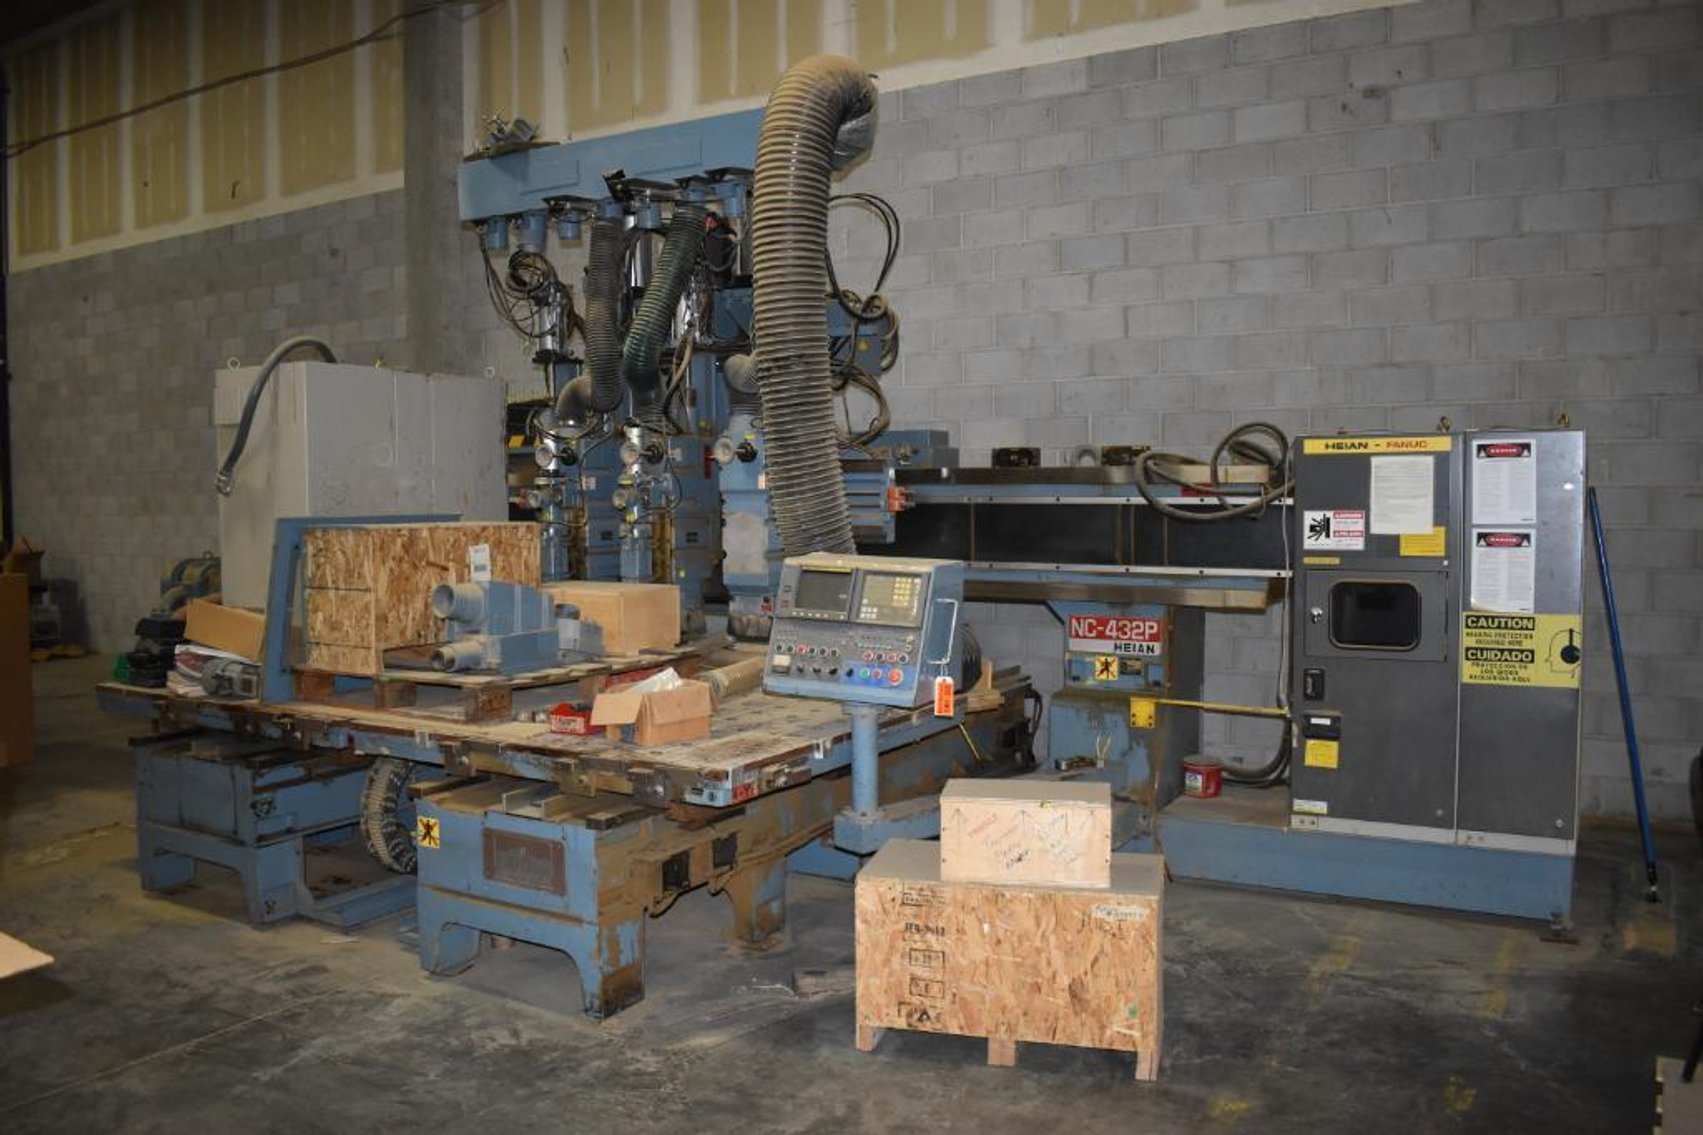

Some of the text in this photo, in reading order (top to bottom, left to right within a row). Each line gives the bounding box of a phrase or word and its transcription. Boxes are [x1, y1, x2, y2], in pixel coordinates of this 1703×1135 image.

[1325, 441, 1369, 451] HEIAN
[1386, 440, 1427, 449] FANUC
[1071, 618, 1158, 640] NC-432P
[1467, 616, 1533, 629] CAUTION
[1114, 642, 1155, 654] HEIAN
[1467, 649, 1532, 662] CUIDADO
